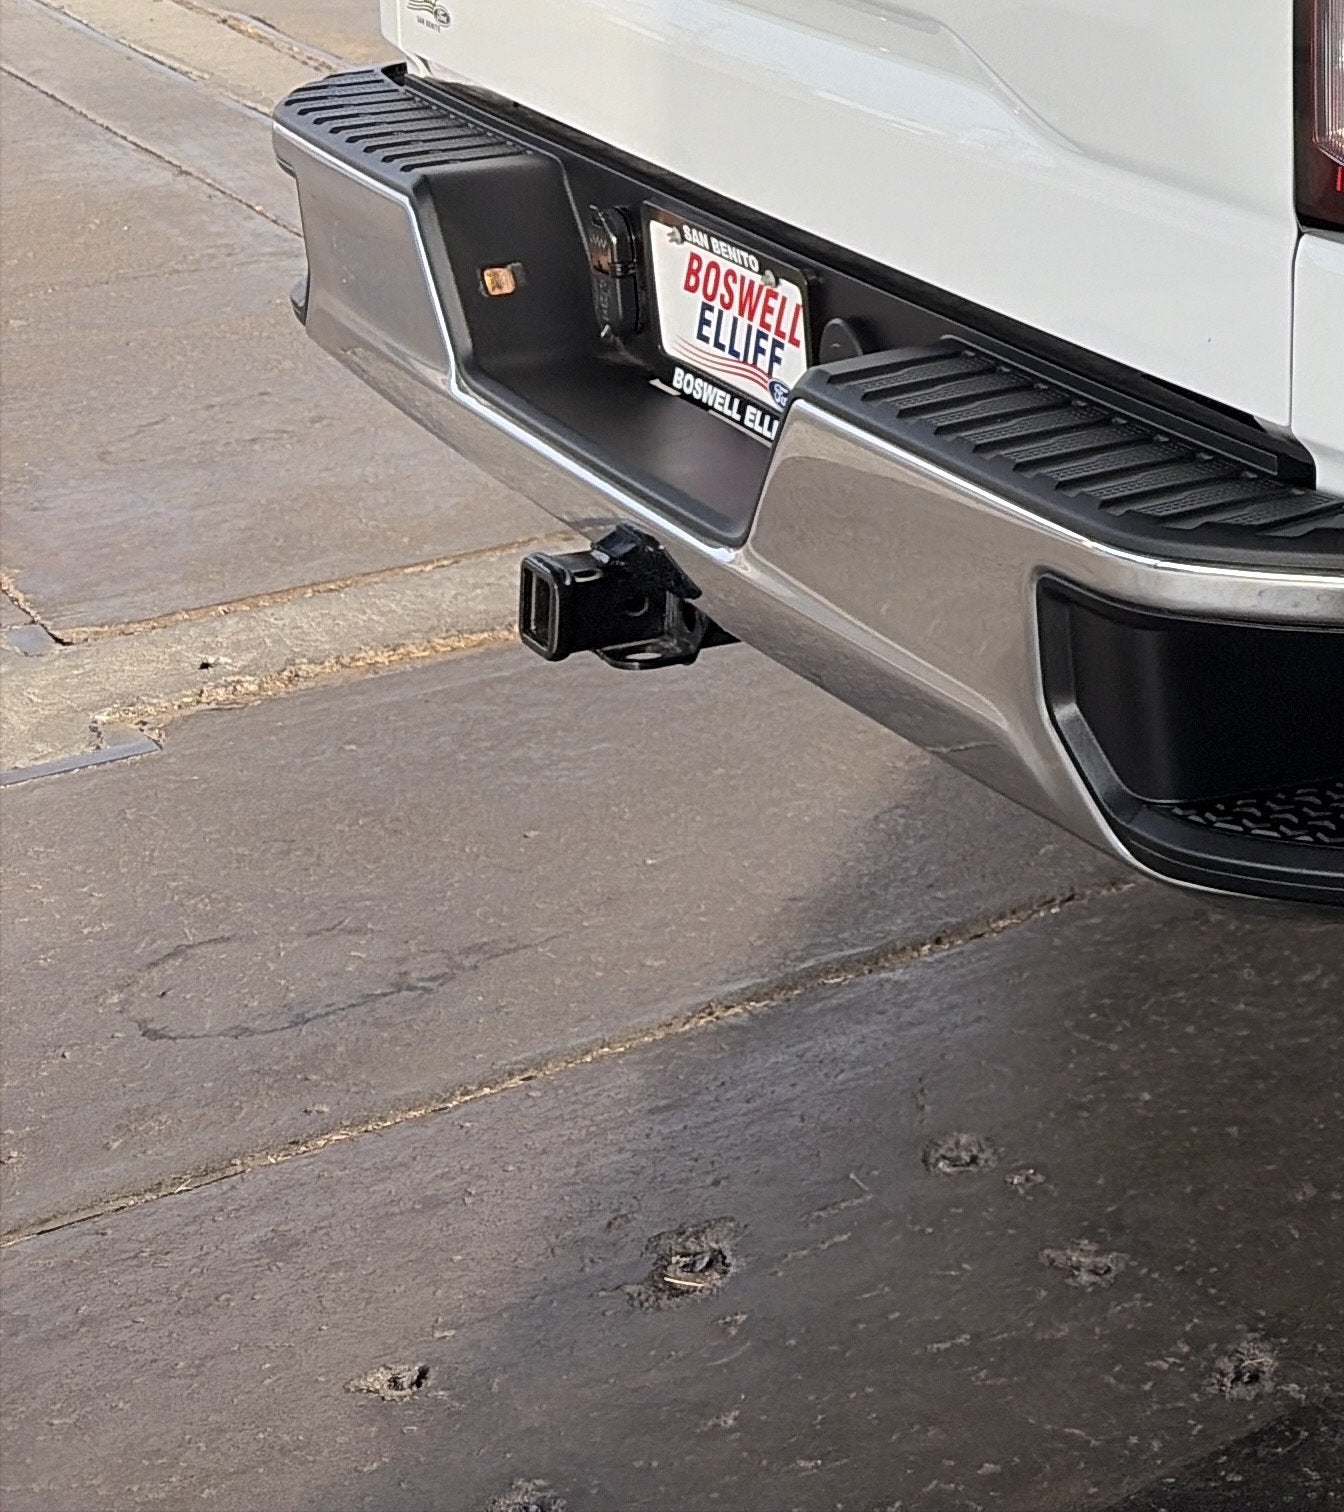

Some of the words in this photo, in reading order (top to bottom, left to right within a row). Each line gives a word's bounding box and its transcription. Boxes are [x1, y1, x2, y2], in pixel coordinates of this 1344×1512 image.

[682, 225, 710, 250] SAN
[711, 237, 760, 274] BENITO
[683, 251, 803, 349] BOSWELL
[696, 301, 785, 378] ELLIFF
[673, 367, 742, 421] BOSWELL
[743, 405, 779, 440] ELLI
